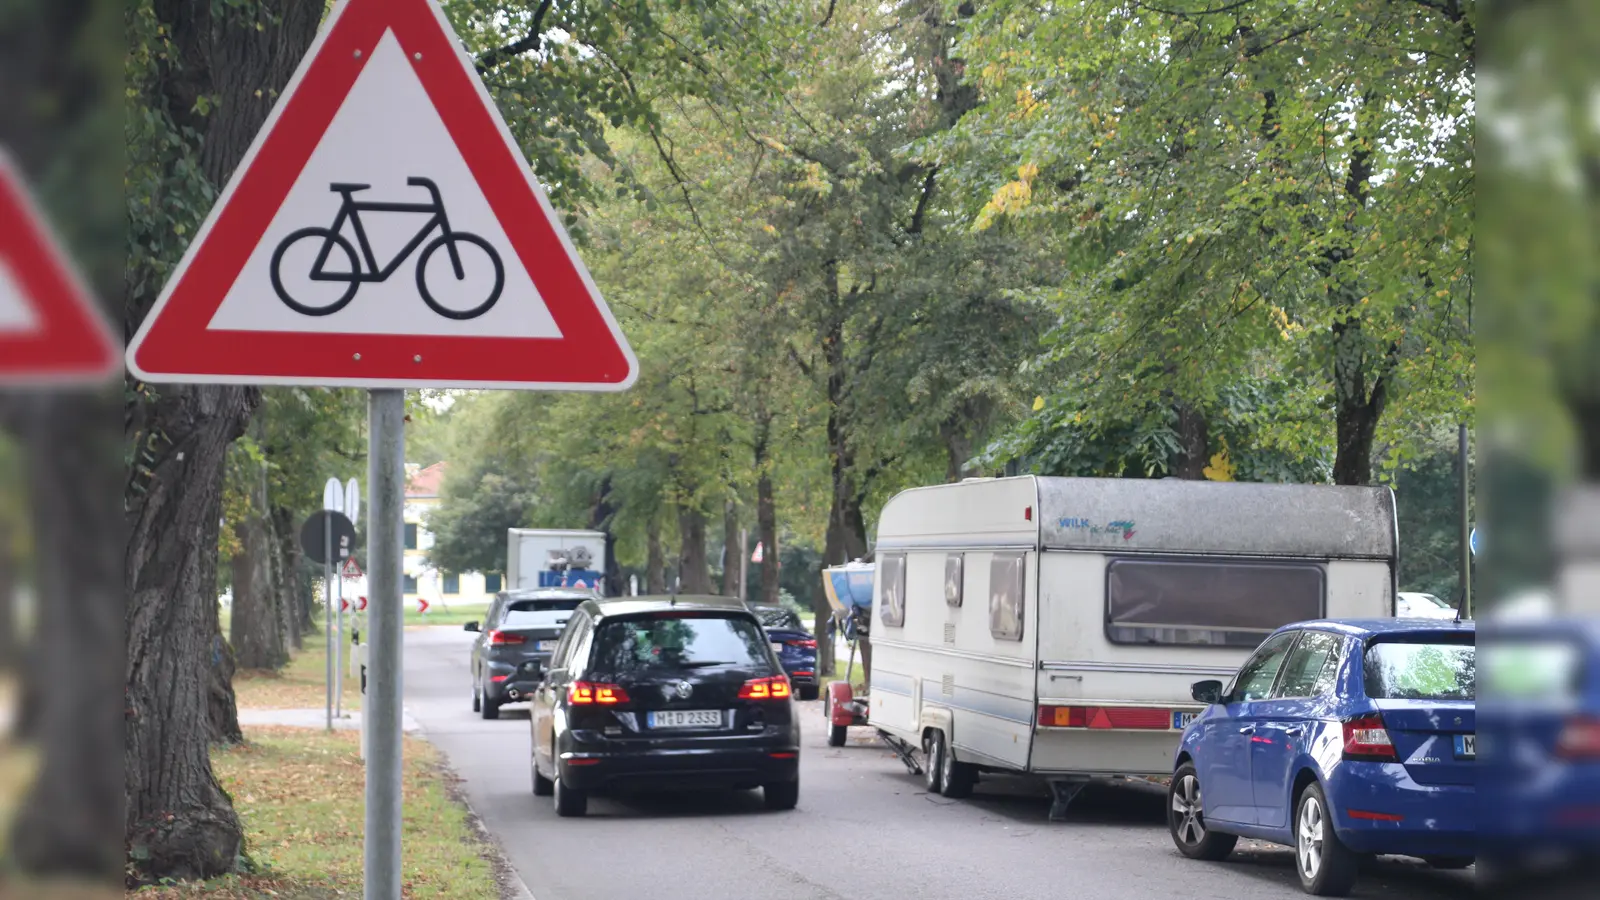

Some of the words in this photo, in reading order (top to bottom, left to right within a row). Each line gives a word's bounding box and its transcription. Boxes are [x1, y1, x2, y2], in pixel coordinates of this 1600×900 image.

[1058, 517, 1089, 528] WILK
[657, 712, 666, 725] M
[676, 712, 684, 724] D
[688, 711, 718, 724] 2333
